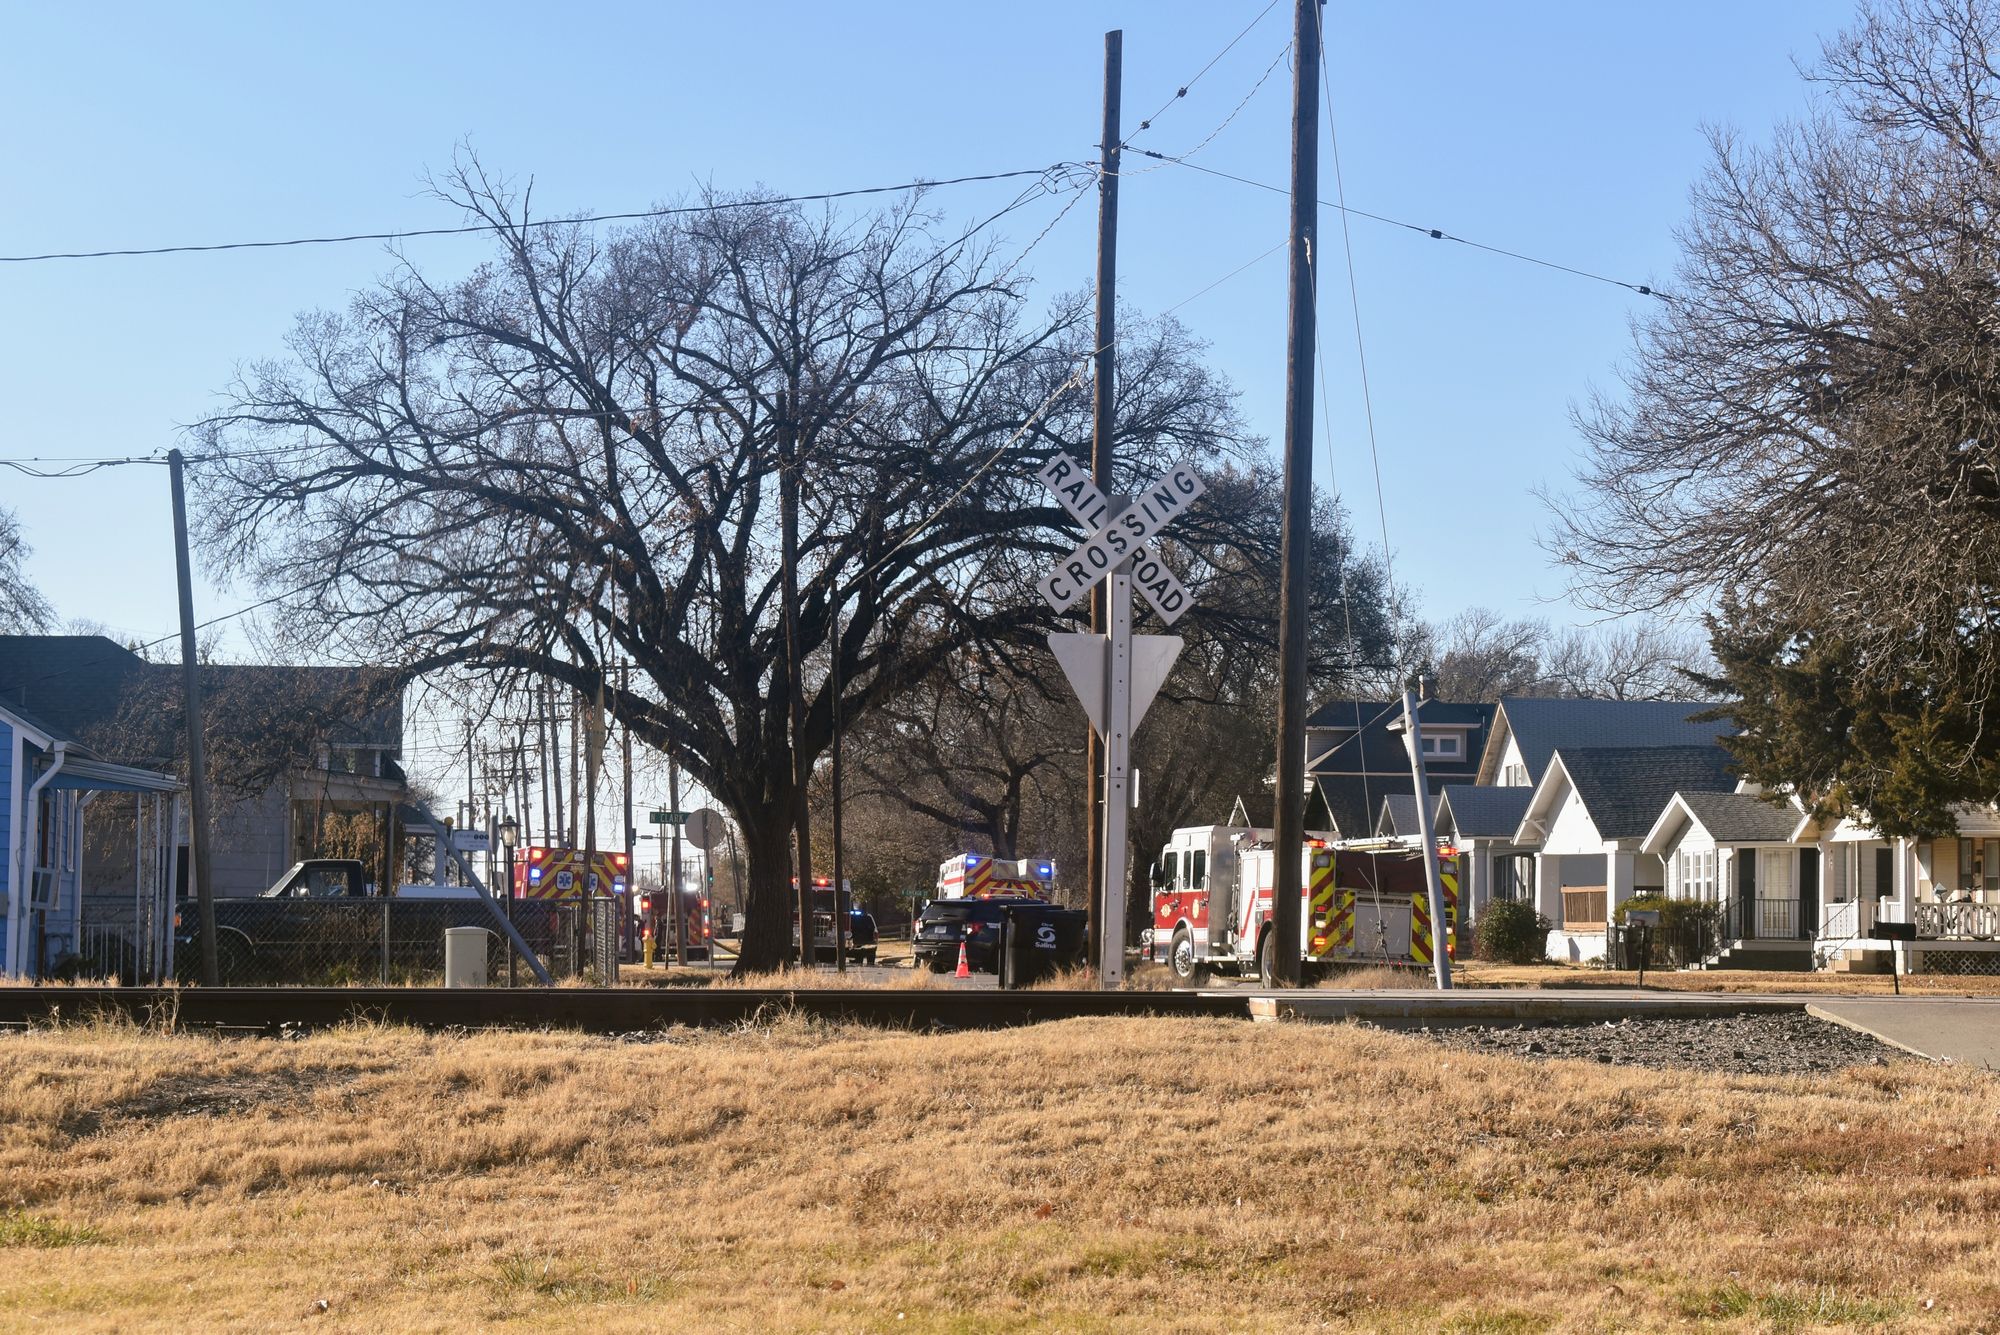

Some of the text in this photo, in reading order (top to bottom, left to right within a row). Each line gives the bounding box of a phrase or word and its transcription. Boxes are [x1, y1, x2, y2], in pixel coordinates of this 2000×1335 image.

[1047, 459, 1184, 613] RAIL ROAD
[1049, 471, 1195, 601] CROSSING
[651, 813, 684, 823] N CLARK
[1035, 941, 1057, 949] Salina
